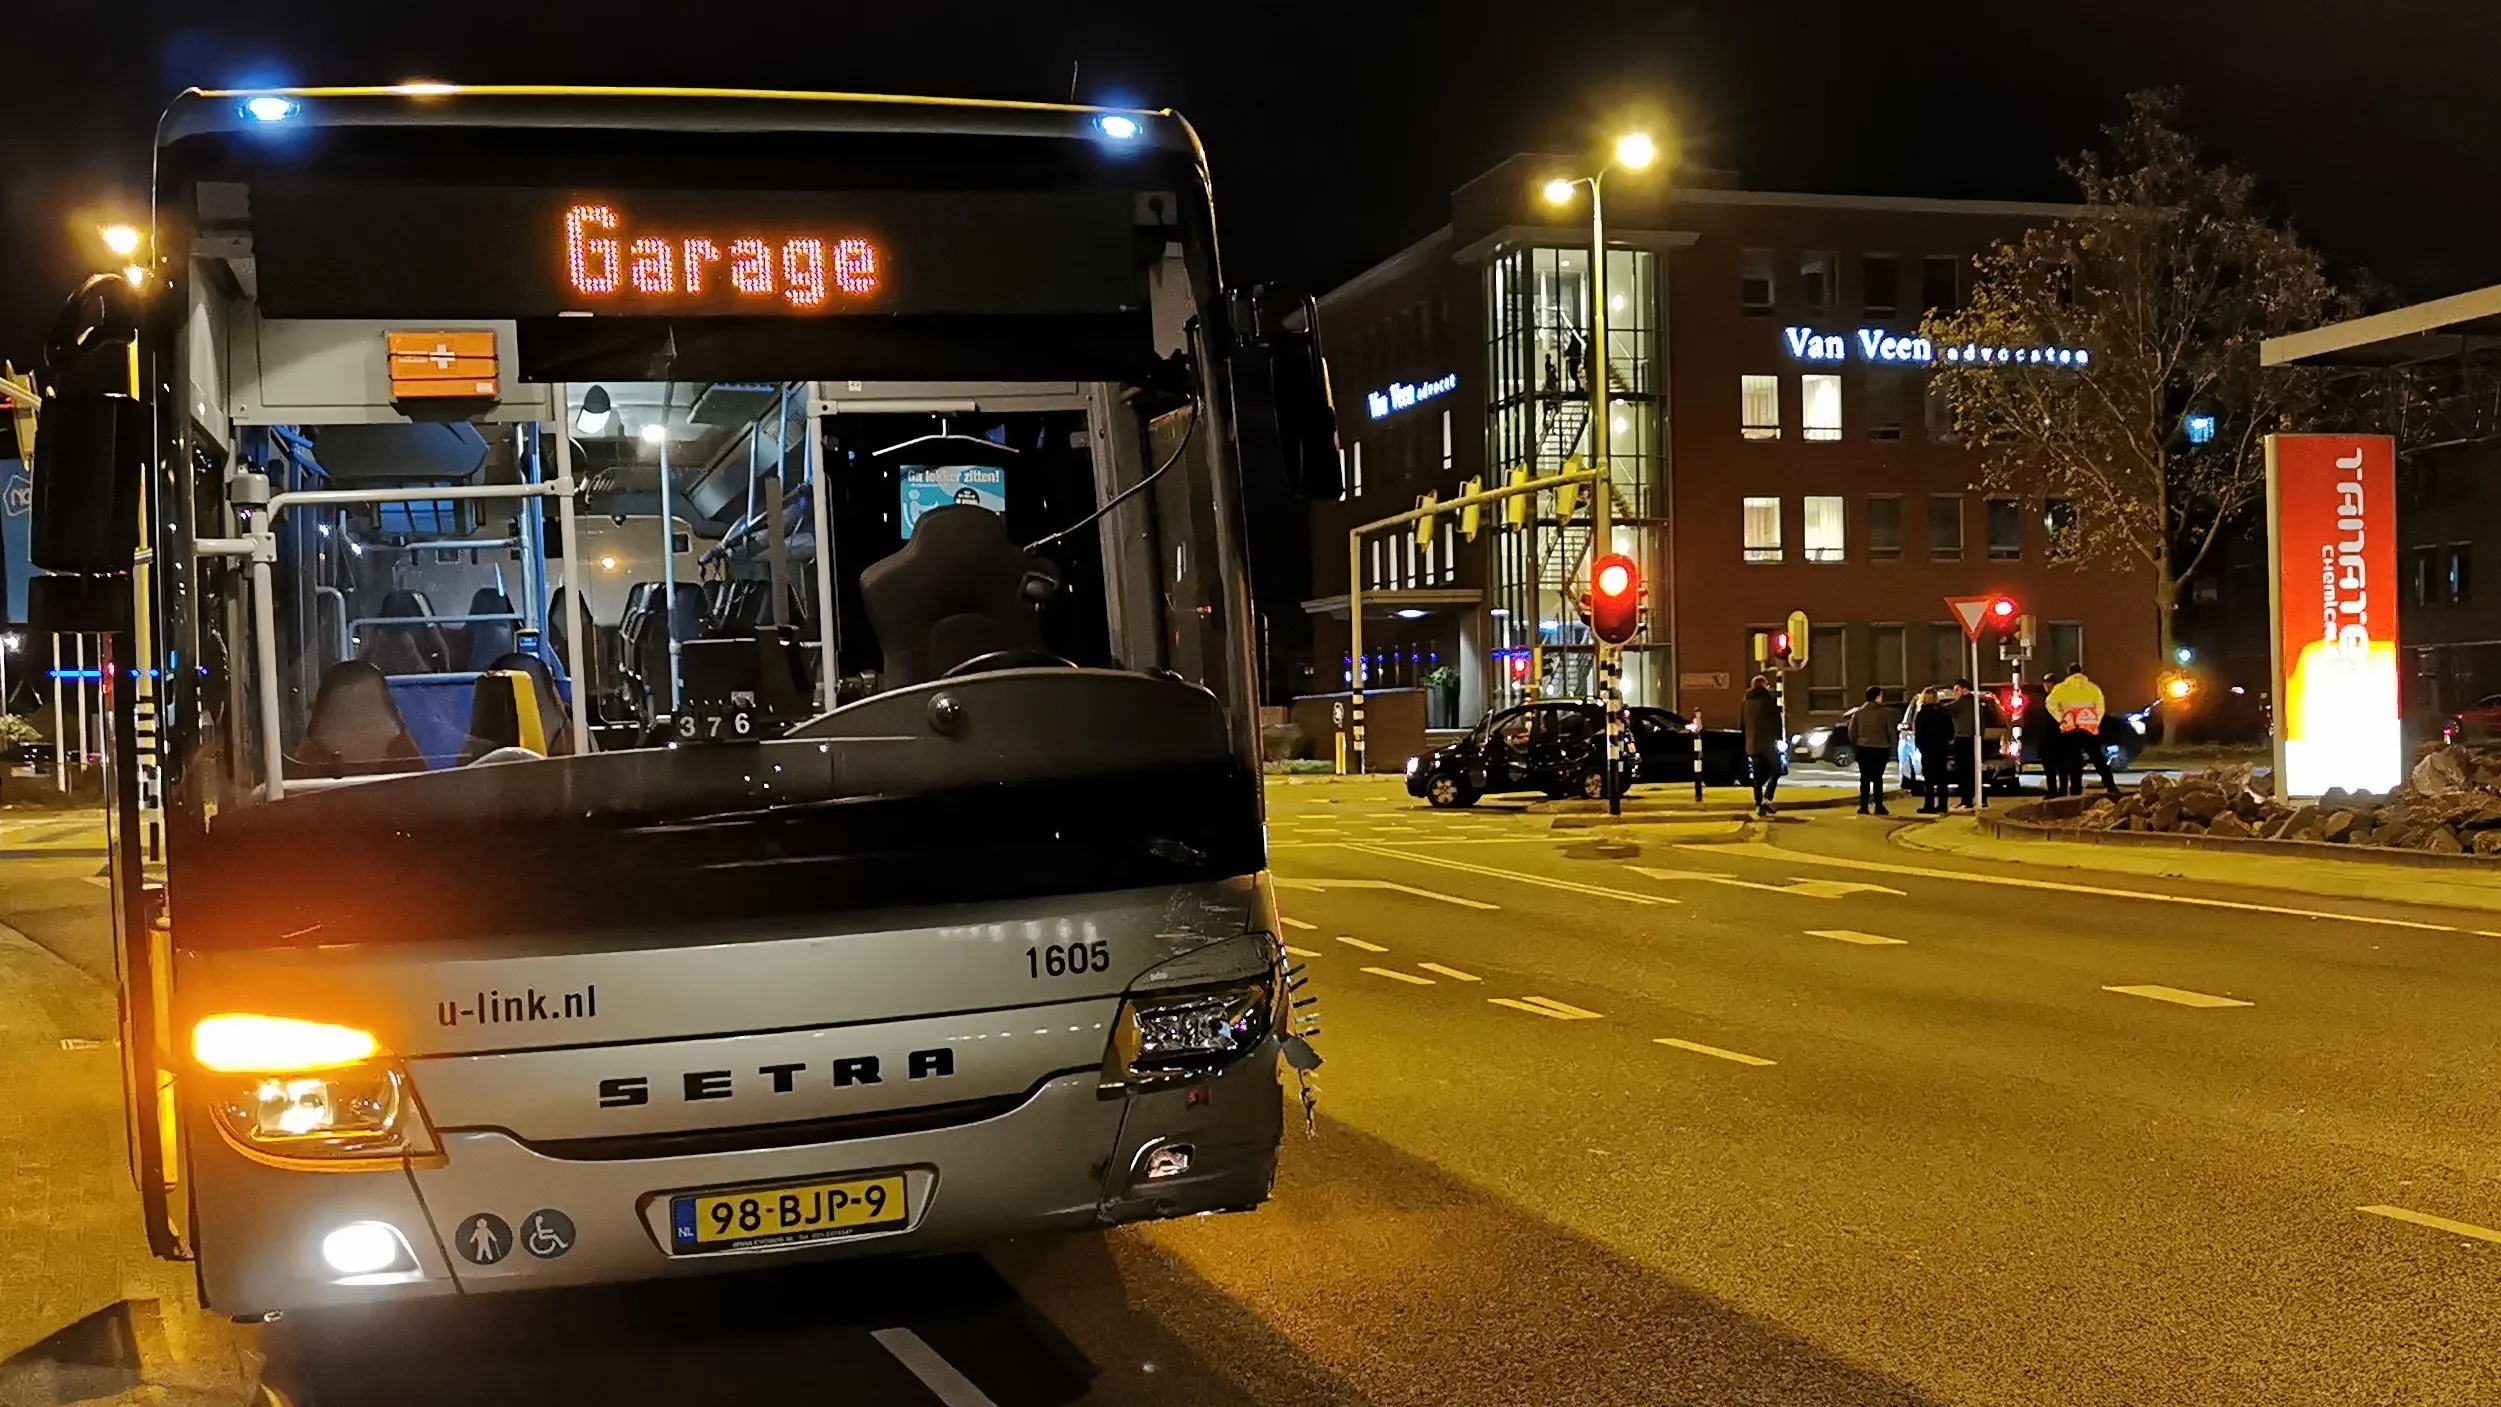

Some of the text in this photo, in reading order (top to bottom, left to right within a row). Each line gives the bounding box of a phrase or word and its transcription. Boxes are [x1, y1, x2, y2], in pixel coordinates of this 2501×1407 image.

[566, 204, 877, 306] Garage
[1785, 326, 2089, 365] Van Veen advocaten
[963, 470, 1000, 484] zitten!
[1026, 940, 1110, 979] 1605
[438, 985, 597, 1027] u-link.nl
[599, 1047, 955, 1109] SETRA
[677, 1225, 695, 1238] NL
[711, 1184, 887, 1235] 98-BJP-9
